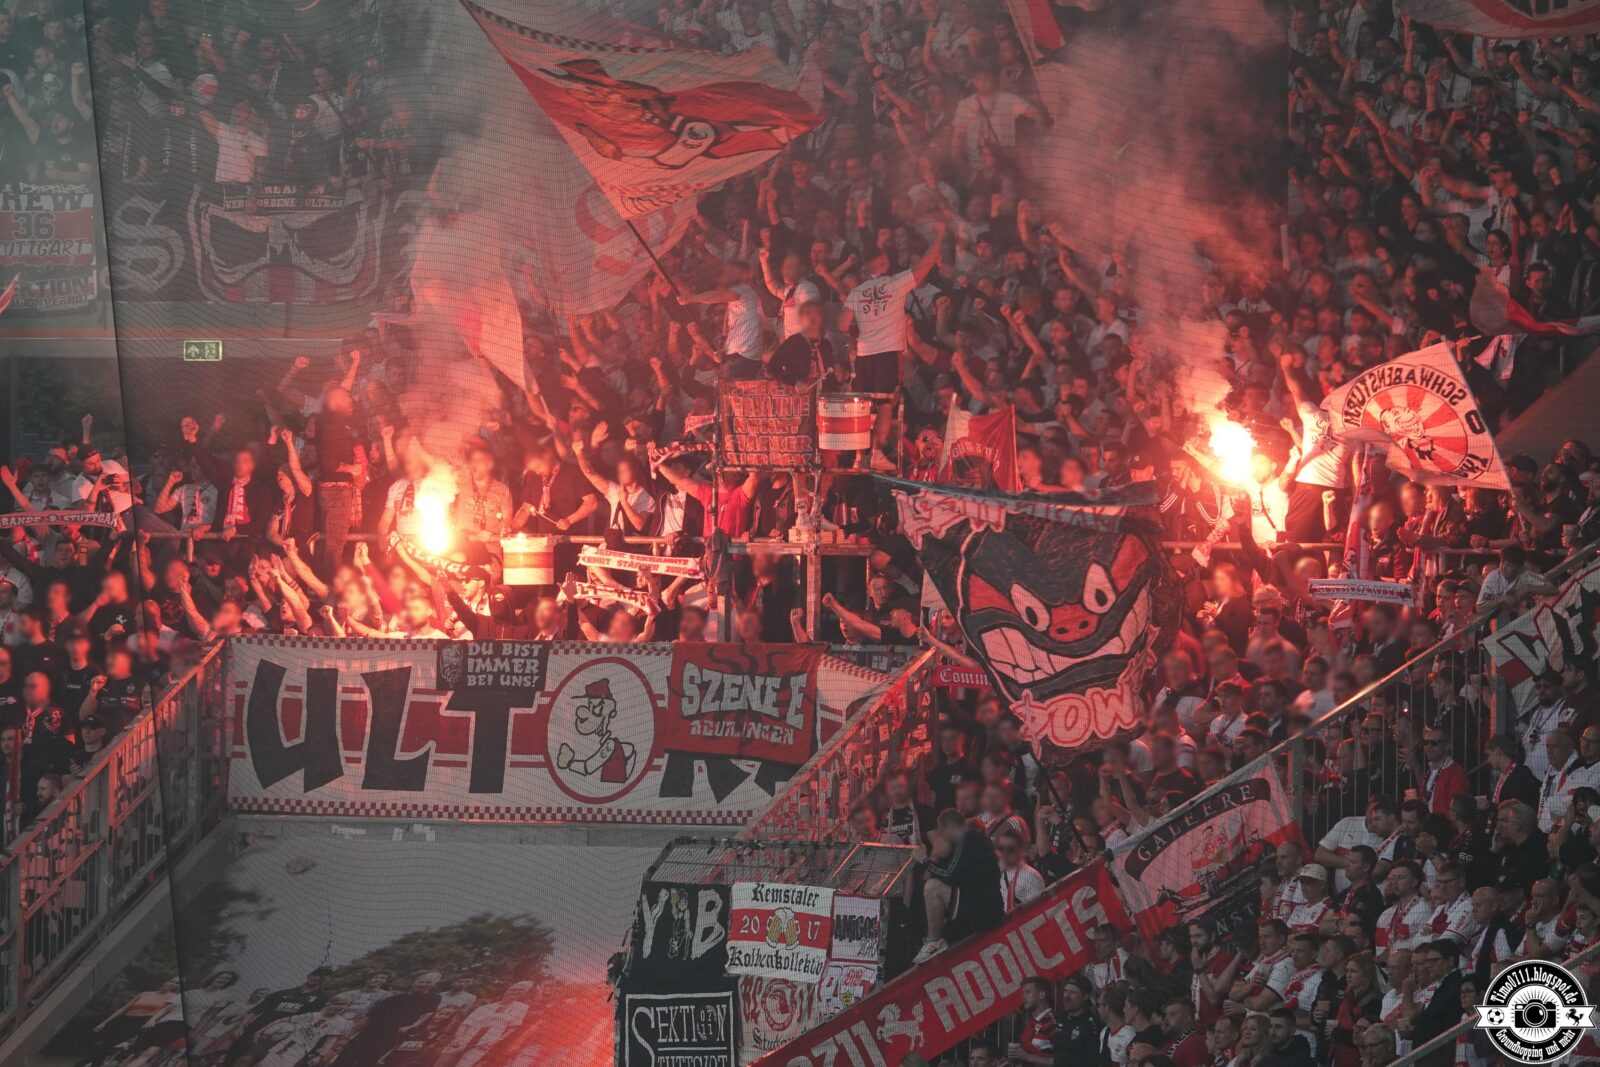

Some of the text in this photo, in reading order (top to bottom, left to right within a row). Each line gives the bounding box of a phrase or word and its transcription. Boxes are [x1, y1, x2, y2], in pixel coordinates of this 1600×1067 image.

[12, 211, 56, 241] 36
[467, 641, 544, 657] DU BIST
[467, 657, 540, 674] IMMER
[466, 674, 541, 688] BEI UNS!
[681, 661, 782, 718] SZENE
[1009, 687, 1141, 758] POW
[1137, 784, 1256, 862] GALEERE
[751, 883, 820, 907] Remstaler
[740, 915, 821, 940] 20 17
[923, 886, 1110, 1032] ADDICTS
